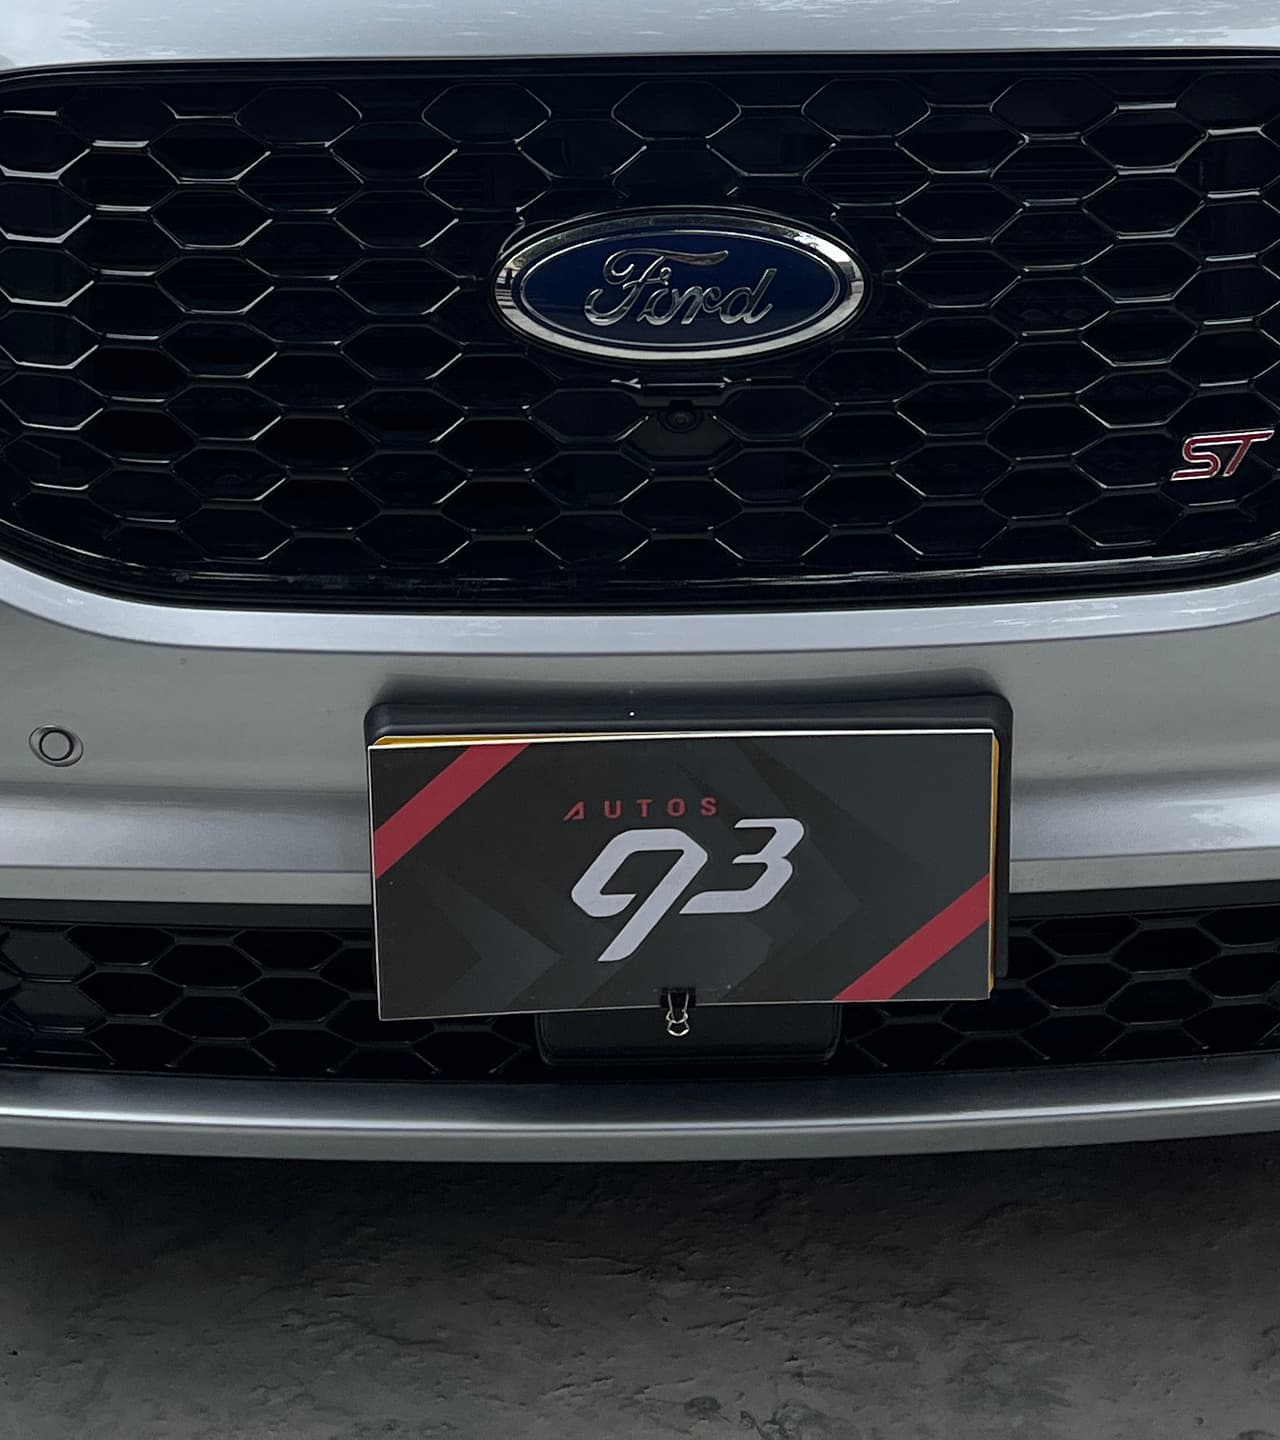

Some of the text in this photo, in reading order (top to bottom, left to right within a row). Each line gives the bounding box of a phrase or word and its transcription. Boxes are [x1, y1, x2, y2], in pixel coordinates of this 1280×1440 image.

[584, 249, 777, 327] Ford
[1170, 429, 1275, 481] ST
[563, 796, 719, 821] AUTOS
[571, 817, 805, 962] 93
